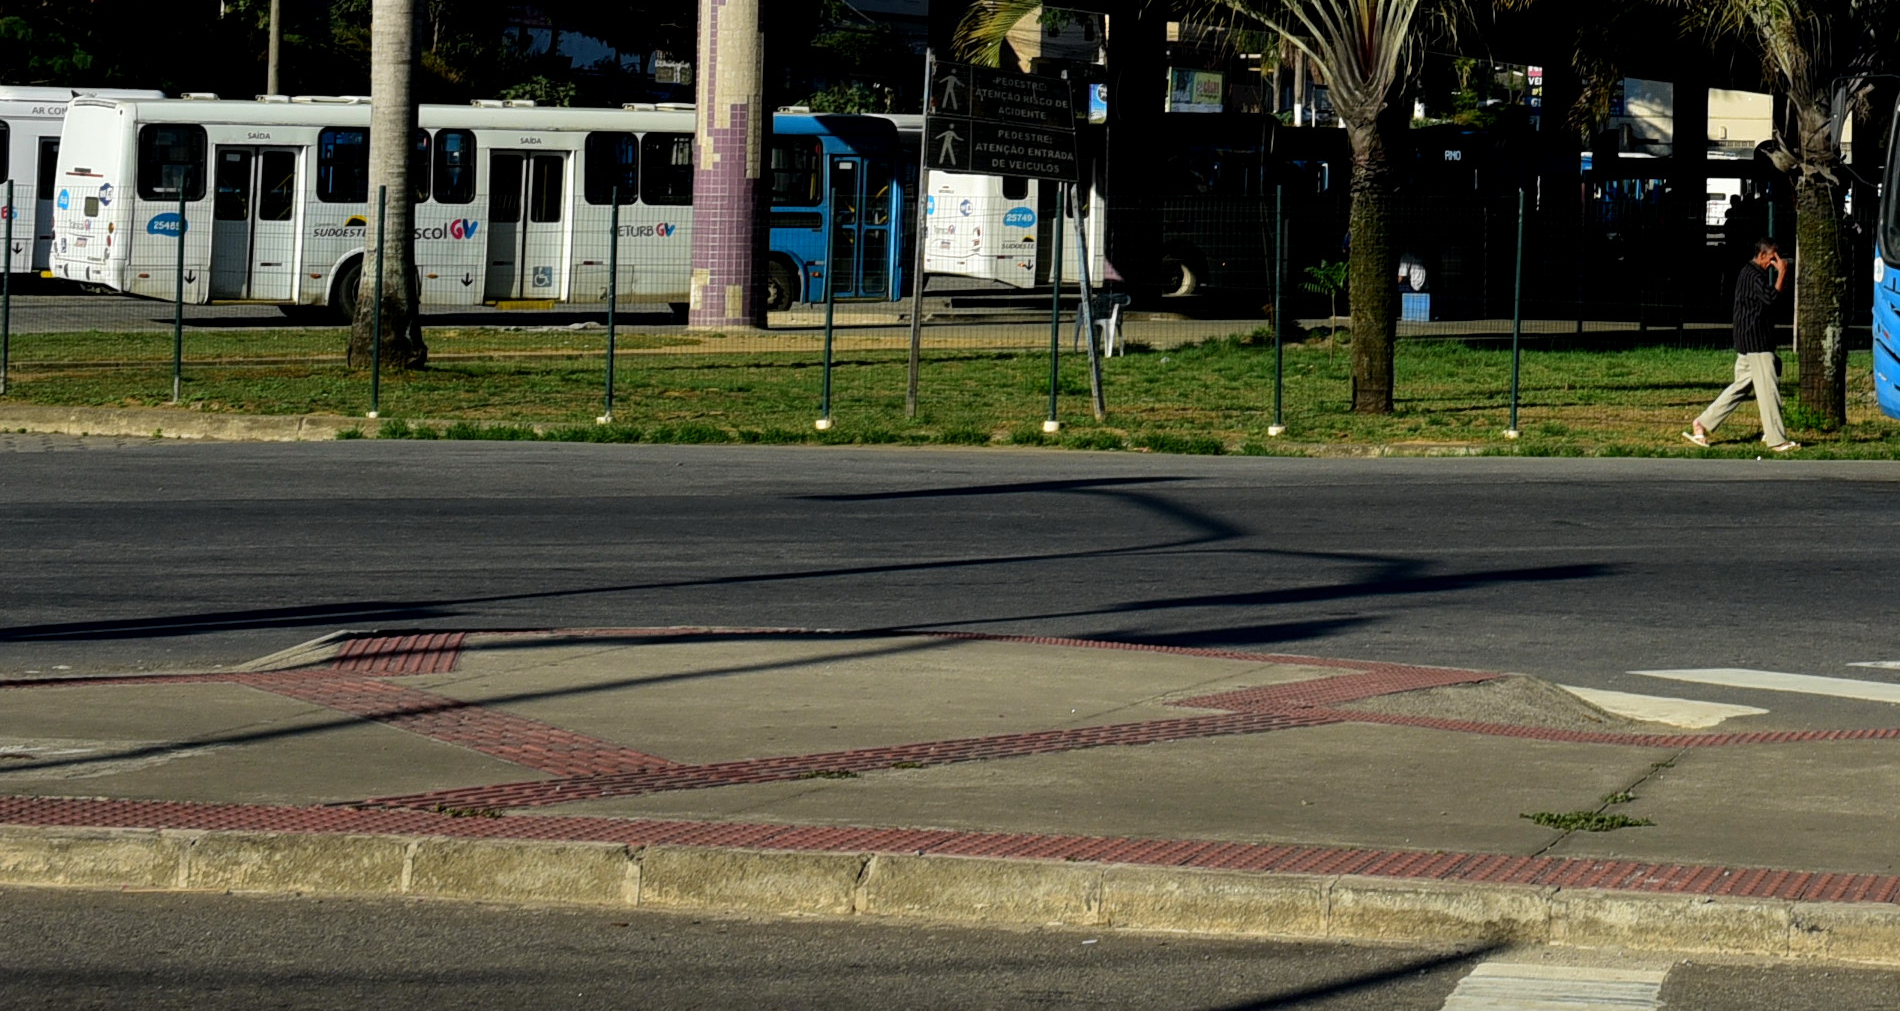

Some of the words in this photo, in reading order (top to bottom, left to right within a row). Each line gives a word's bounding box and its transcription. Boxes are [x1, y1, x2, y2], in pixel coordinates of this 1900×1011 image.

[1055, 99, 1069, 109] DE
[31, 106, 45, 114] AR
[998, 106, 1047, 120] ACIDENTE
[247, 131, 270, 140] SAÍDA
[520, 136, 542, 145] SAÍDA
[975, 142, 1025, 156] ATENÇÃO
[1027, 148, 1075, 161] ENTRADA
[991, 158, 1006, 168] DE
[1006, 213, 1034, 222] 25749
